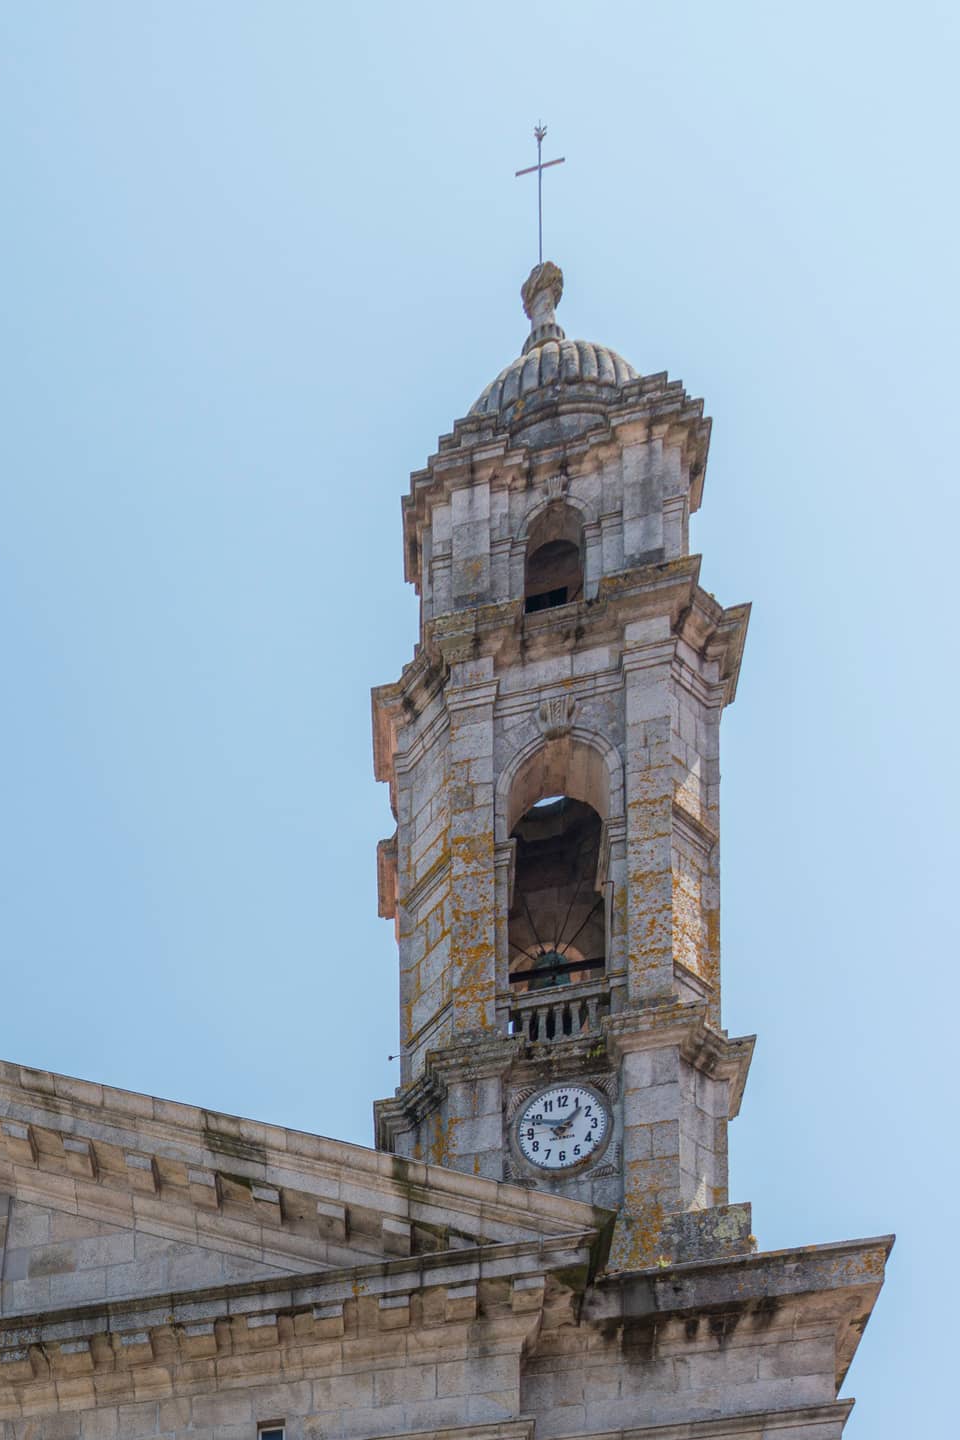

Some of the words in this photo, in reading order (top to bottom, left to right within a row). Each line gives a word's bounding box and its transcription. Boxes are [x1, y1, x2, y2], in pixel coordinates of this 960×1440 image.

[543, 1100, 553, 1113] 11
[557, 1095, 568, 1108] 12
[574, 1097, 579, 1108] 1
[584, 1105, 592, 1118] 2
[591, 1117, 598, 1129] 3
[527, 1128, 534, 1140] 9
[584, 1131, 592, 1142] 4
[532, 1141, 539, 1152] 8
[574, 1144, 581, 1155] 5
[544, 1149, 551, 1160] 7
[559, 1150, 566, 1161] 6
